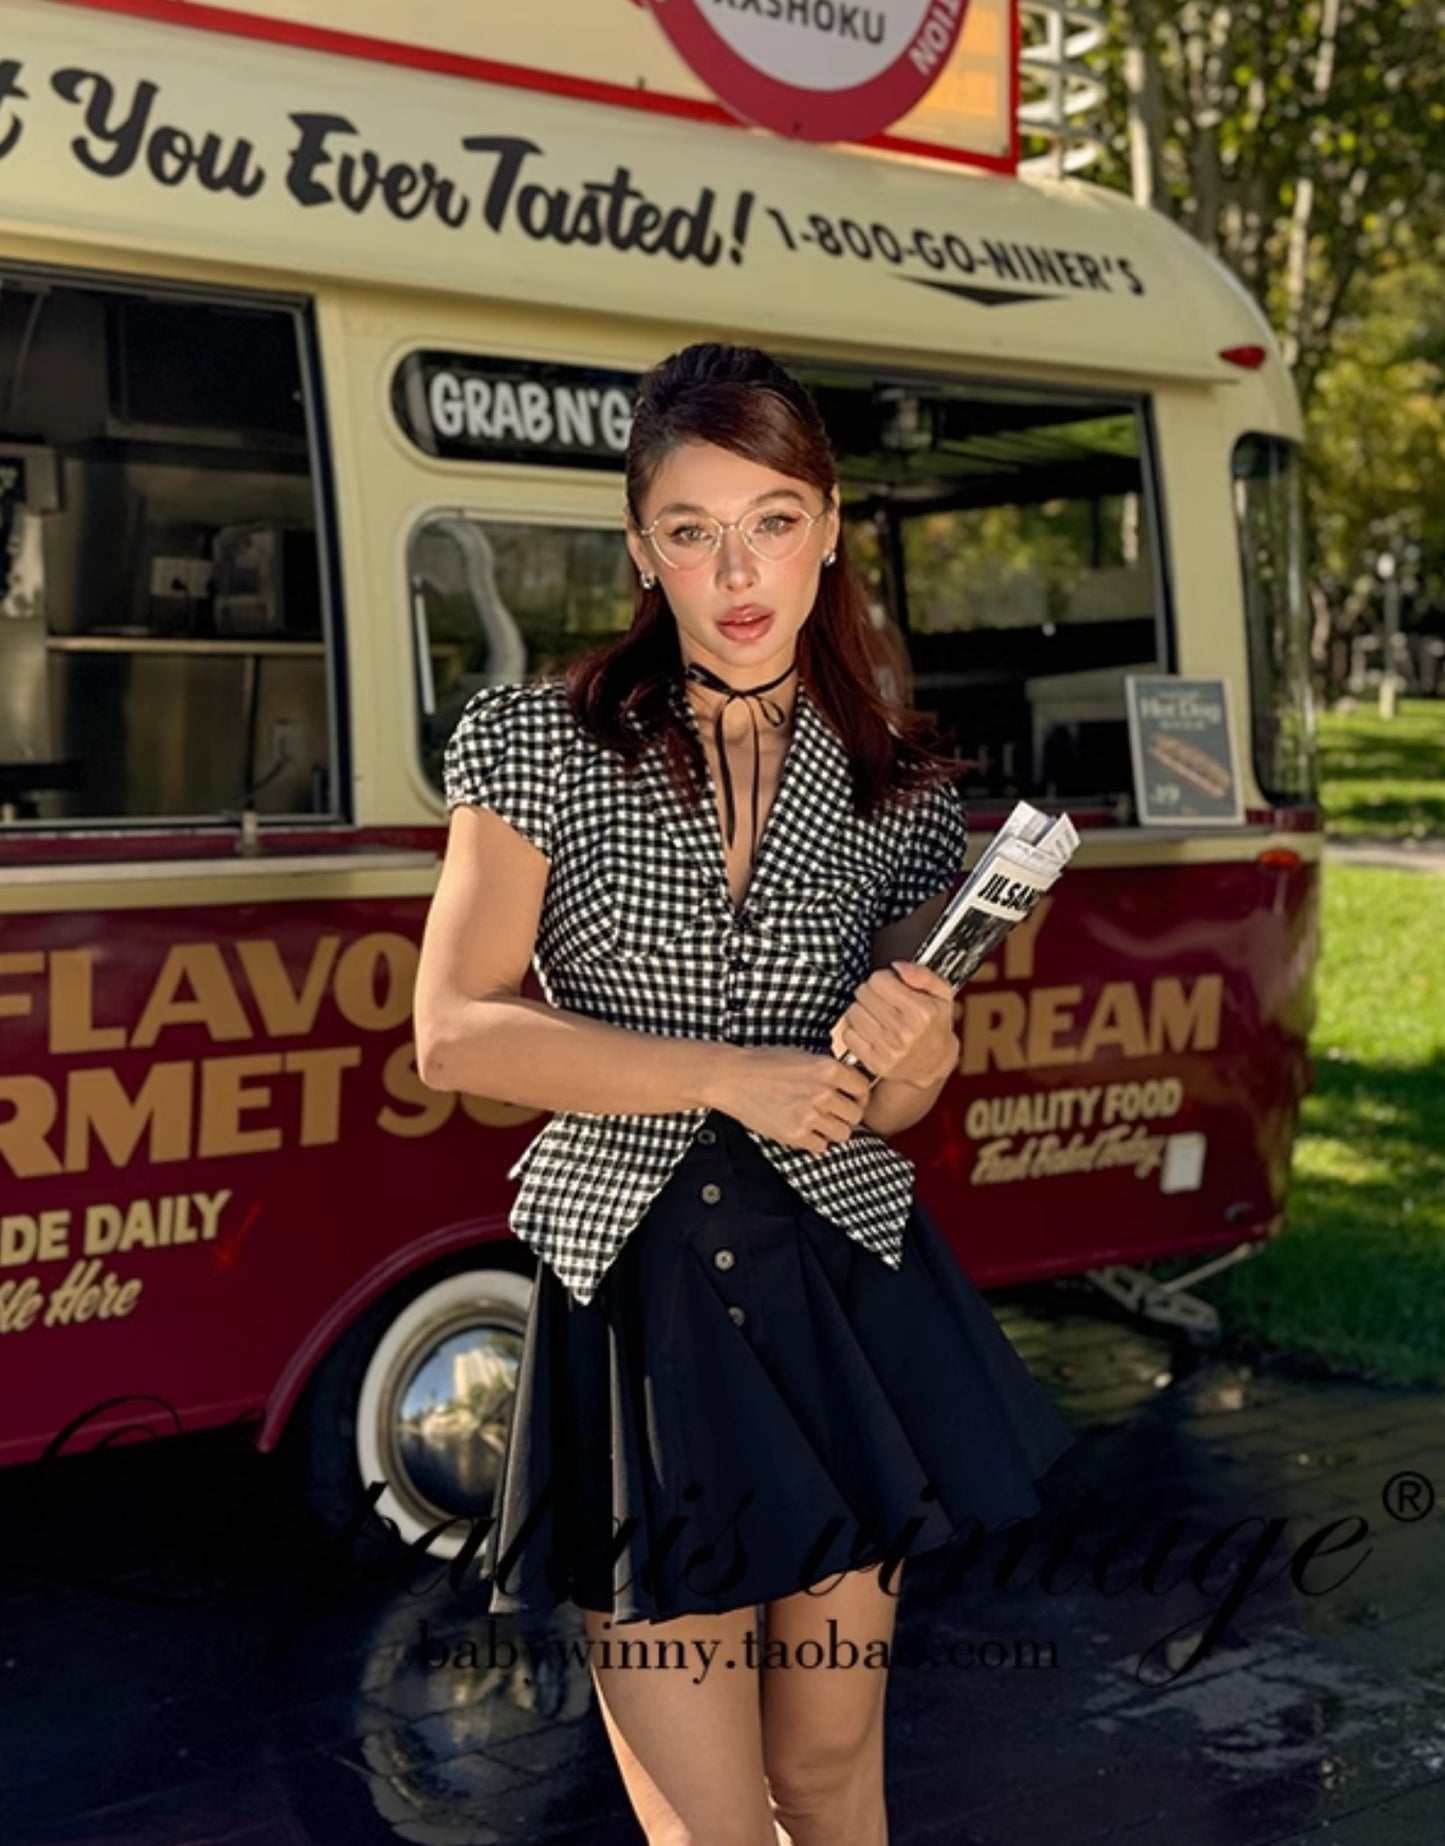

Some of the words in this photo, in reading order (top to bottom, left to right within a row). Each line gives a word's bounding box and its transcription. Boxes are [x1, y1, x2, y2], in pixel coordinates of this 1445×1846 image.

[712, 0, 886, 45] SHOKU
[50, 66, 265, 198] You
[285, 112, 470, 229] Ever
[461, 135, 755, 268] Tasted!
[953, 974, 1223, 1076] REAM
[0, 1046, 361, 1179] RMET
[965, 1086, 1101, 1141] QUALITY
[1102, 1077, 1184, 1124] FOOD
[0, 1209, 71, 1267] DE
[84, 1189, 232, 1257] DAILY
[44, 1258, 142, 1328] Here
